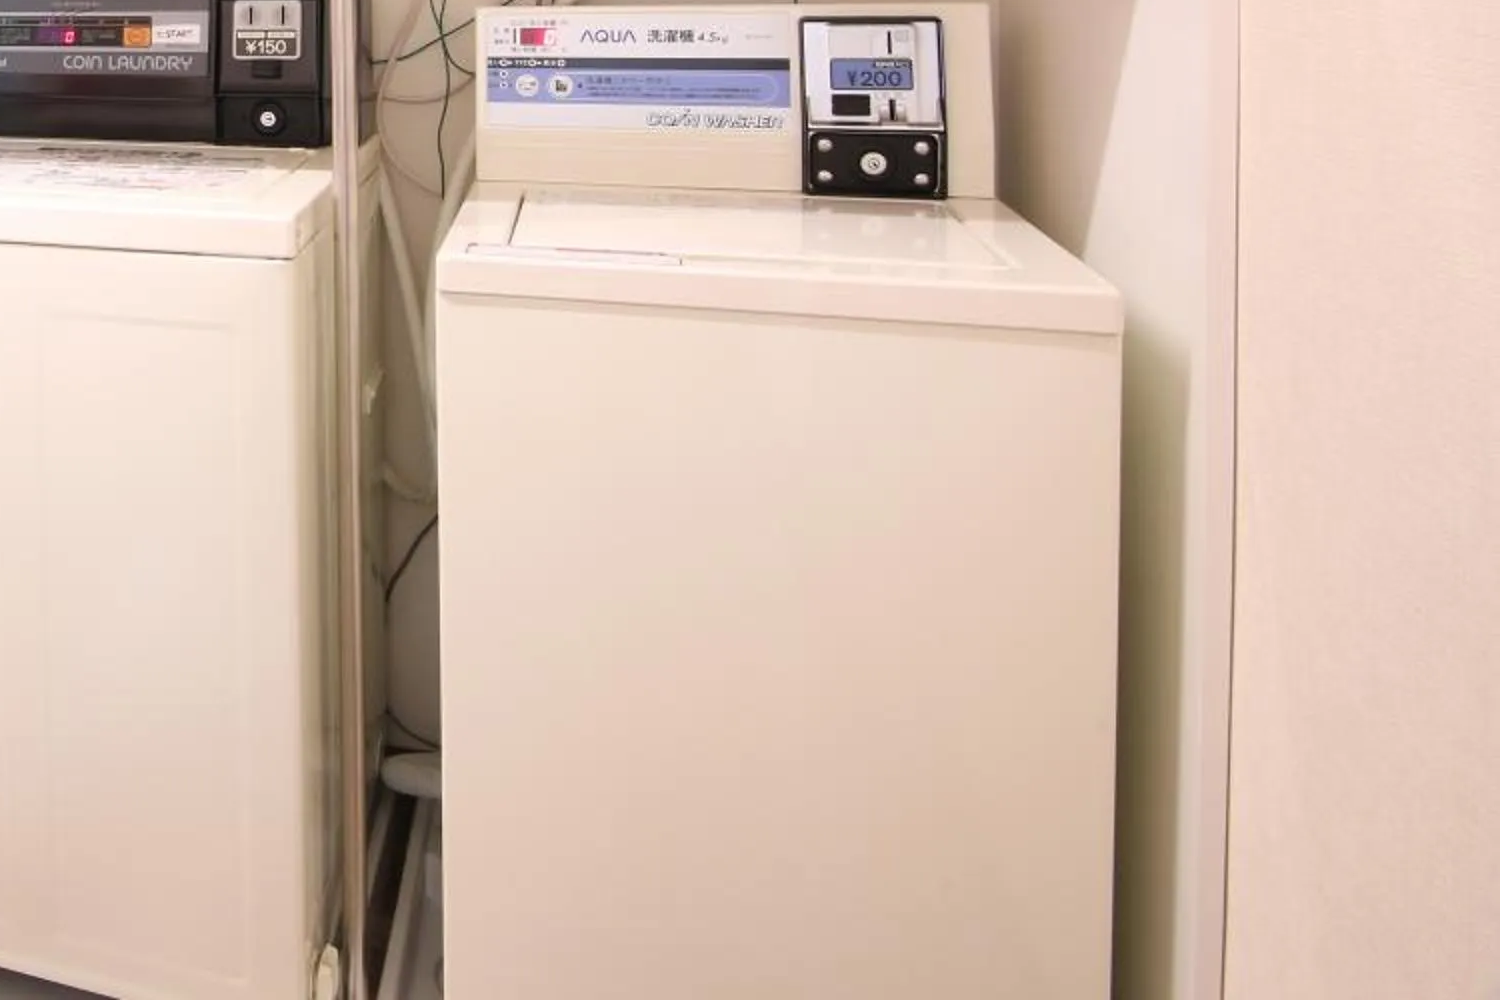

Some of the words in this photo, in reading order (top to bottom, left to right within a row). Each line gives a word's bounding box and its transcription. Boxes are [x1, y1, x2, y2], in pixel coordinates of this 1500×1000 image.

[63, 30, 76, 44] 0
[580, 29, 637, 44] AQUA
[647, 28, 695, 43] 洗濯機
[245, 39, 287, 54] ¥150
[63, 55, 103, 70] COIN
[108, 55, 194, 70] LAUNDRY
[847, 71, 903, 86] ¥200
[704, 112, 785, 129] WASHER
